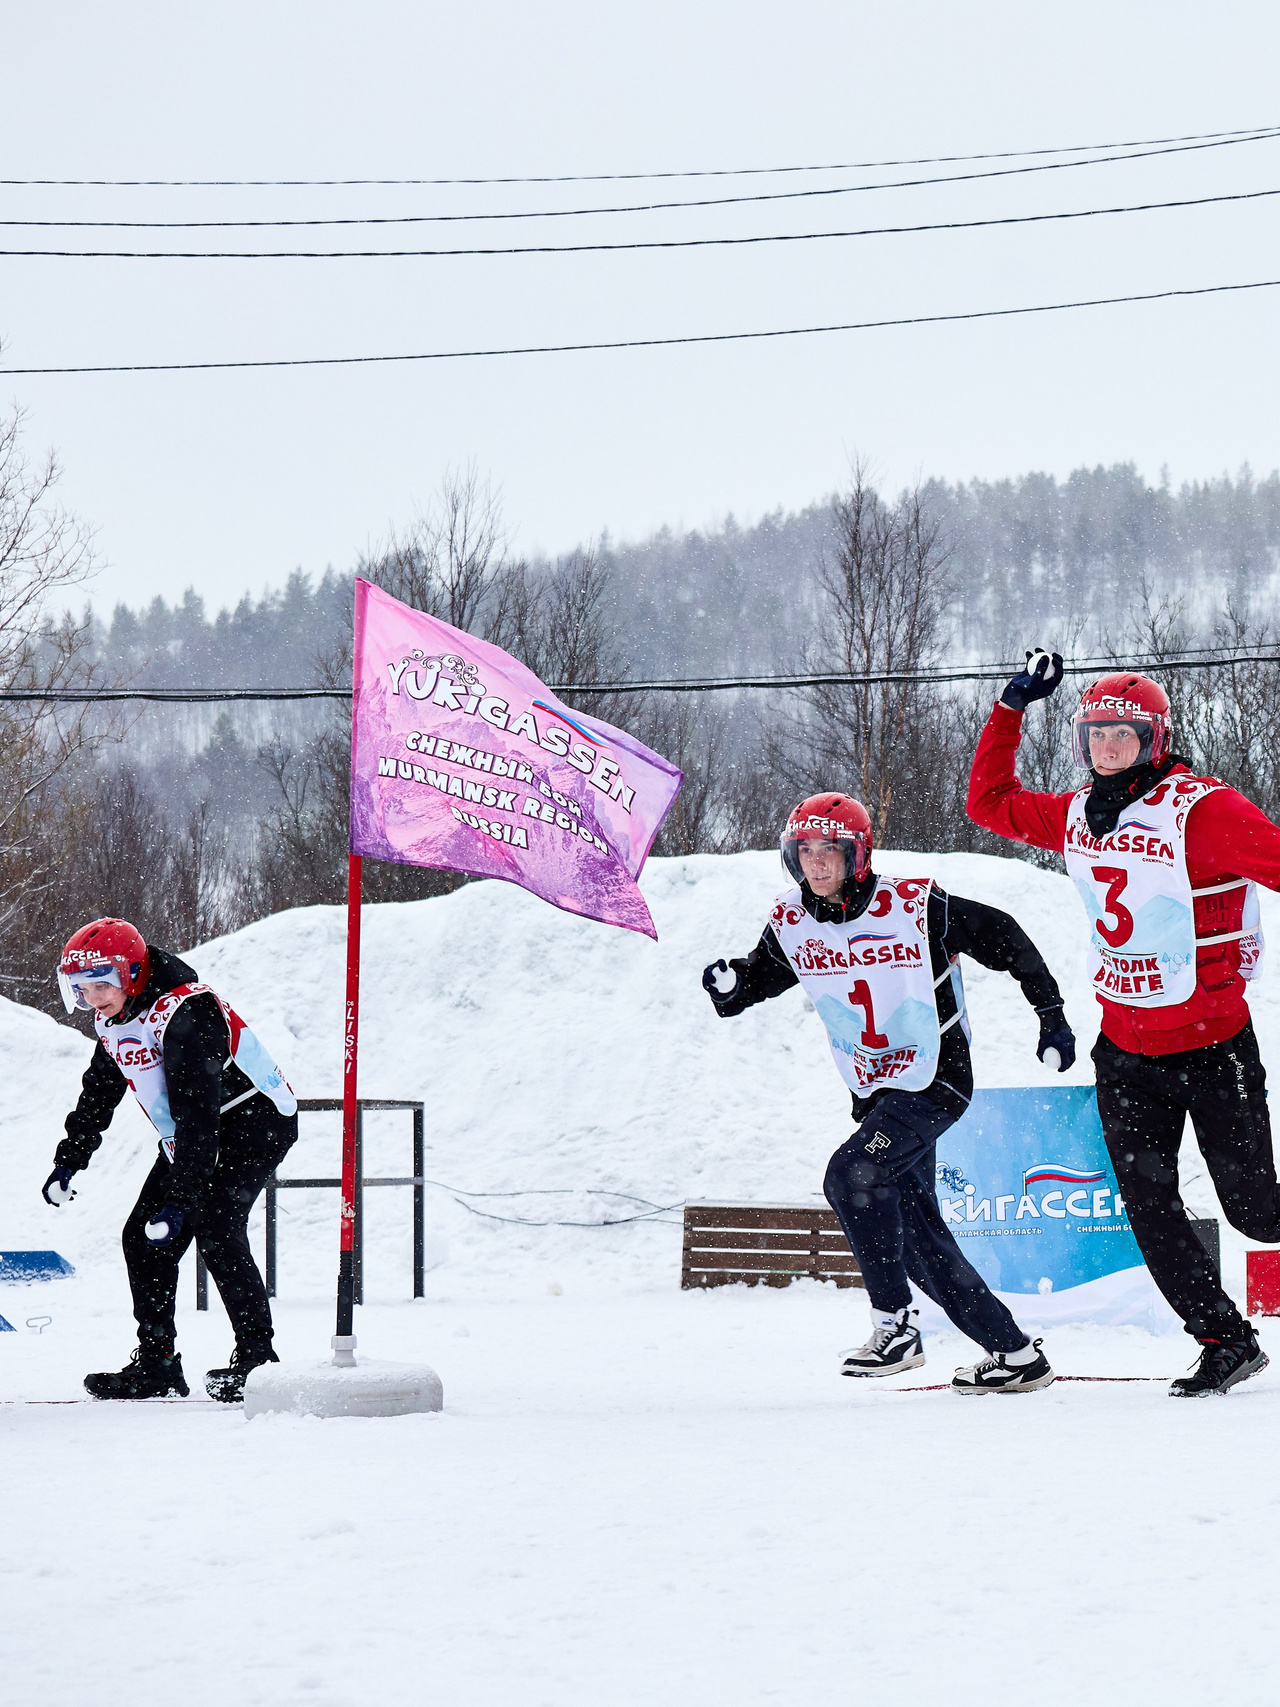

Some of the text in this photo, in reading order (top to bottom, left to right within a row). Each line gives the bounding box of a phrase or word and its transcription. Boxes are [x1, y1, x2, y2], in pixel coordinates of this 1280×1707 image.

[405, 732, 583, 819] СНЕЖНЫЙ БОЙ
[378, 757, 609, 855] MURMANSK REGION
[451, 806, 529, 850] RUSSIA
[1091, 866, 1134, 948] 3
[1094, 965, 1164, 993] В СНЕГЕ
[1112, 957, 1160, 974] ТОЛК
[848, 979, 889, 1049] 1
[344, 1007, 355, 1074] LISKI
[941, 1185, 1125, 1224] КИГАССЕ
[952, 1228, 1043, 1238] РМАНСКАЯ ОБЛАСТЬ
[1077, 1223, 1122, 1233] СНЕЖНЫЙ
